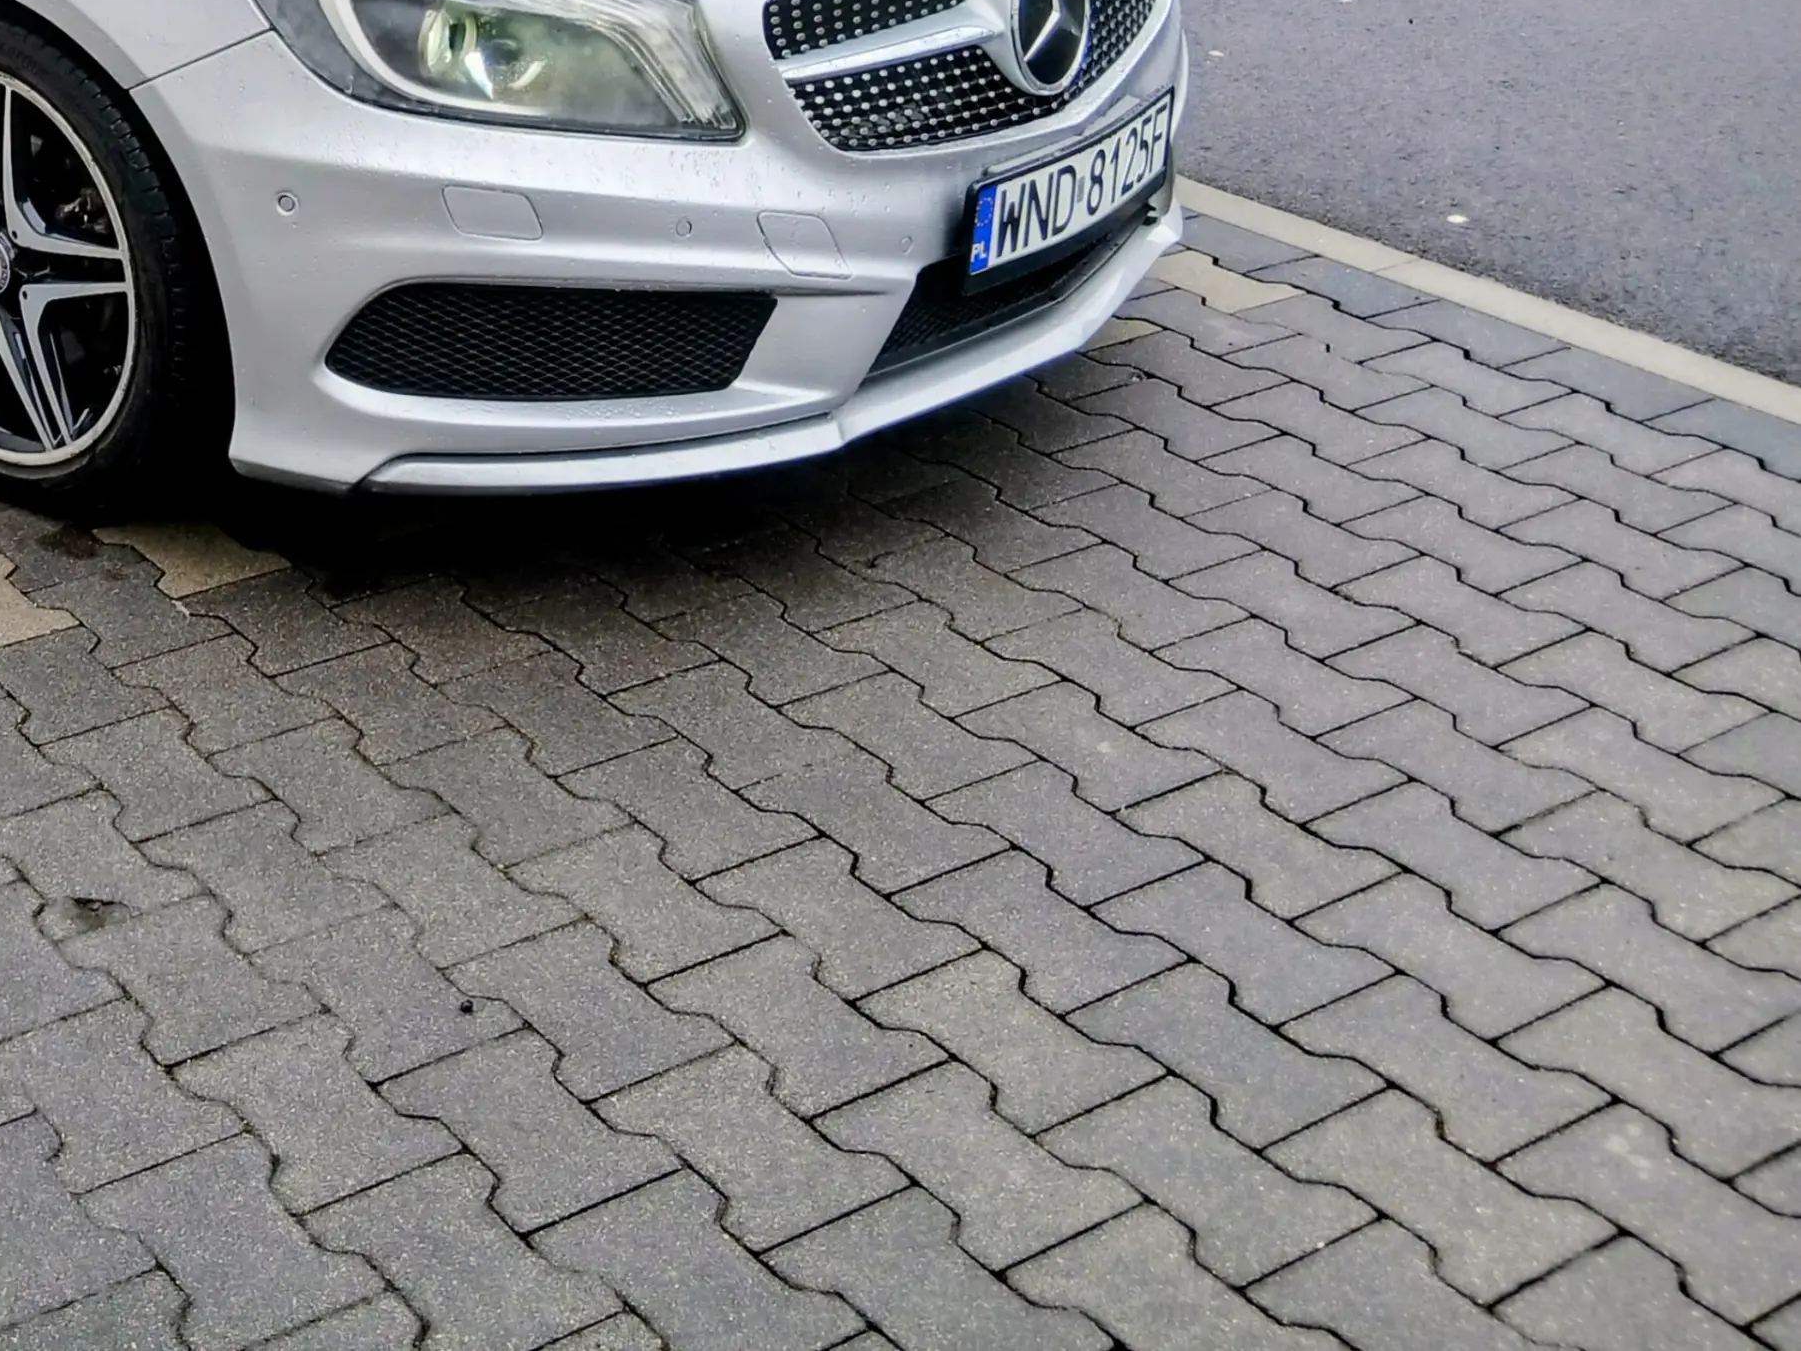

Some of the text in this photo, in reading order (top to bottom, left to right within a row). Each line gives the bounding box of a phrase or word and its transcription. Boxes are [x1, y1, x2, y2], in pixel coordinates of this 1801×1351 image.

[996, 102, 1168, 259] WND 8125F
[970, 240, 987, 263] PL
